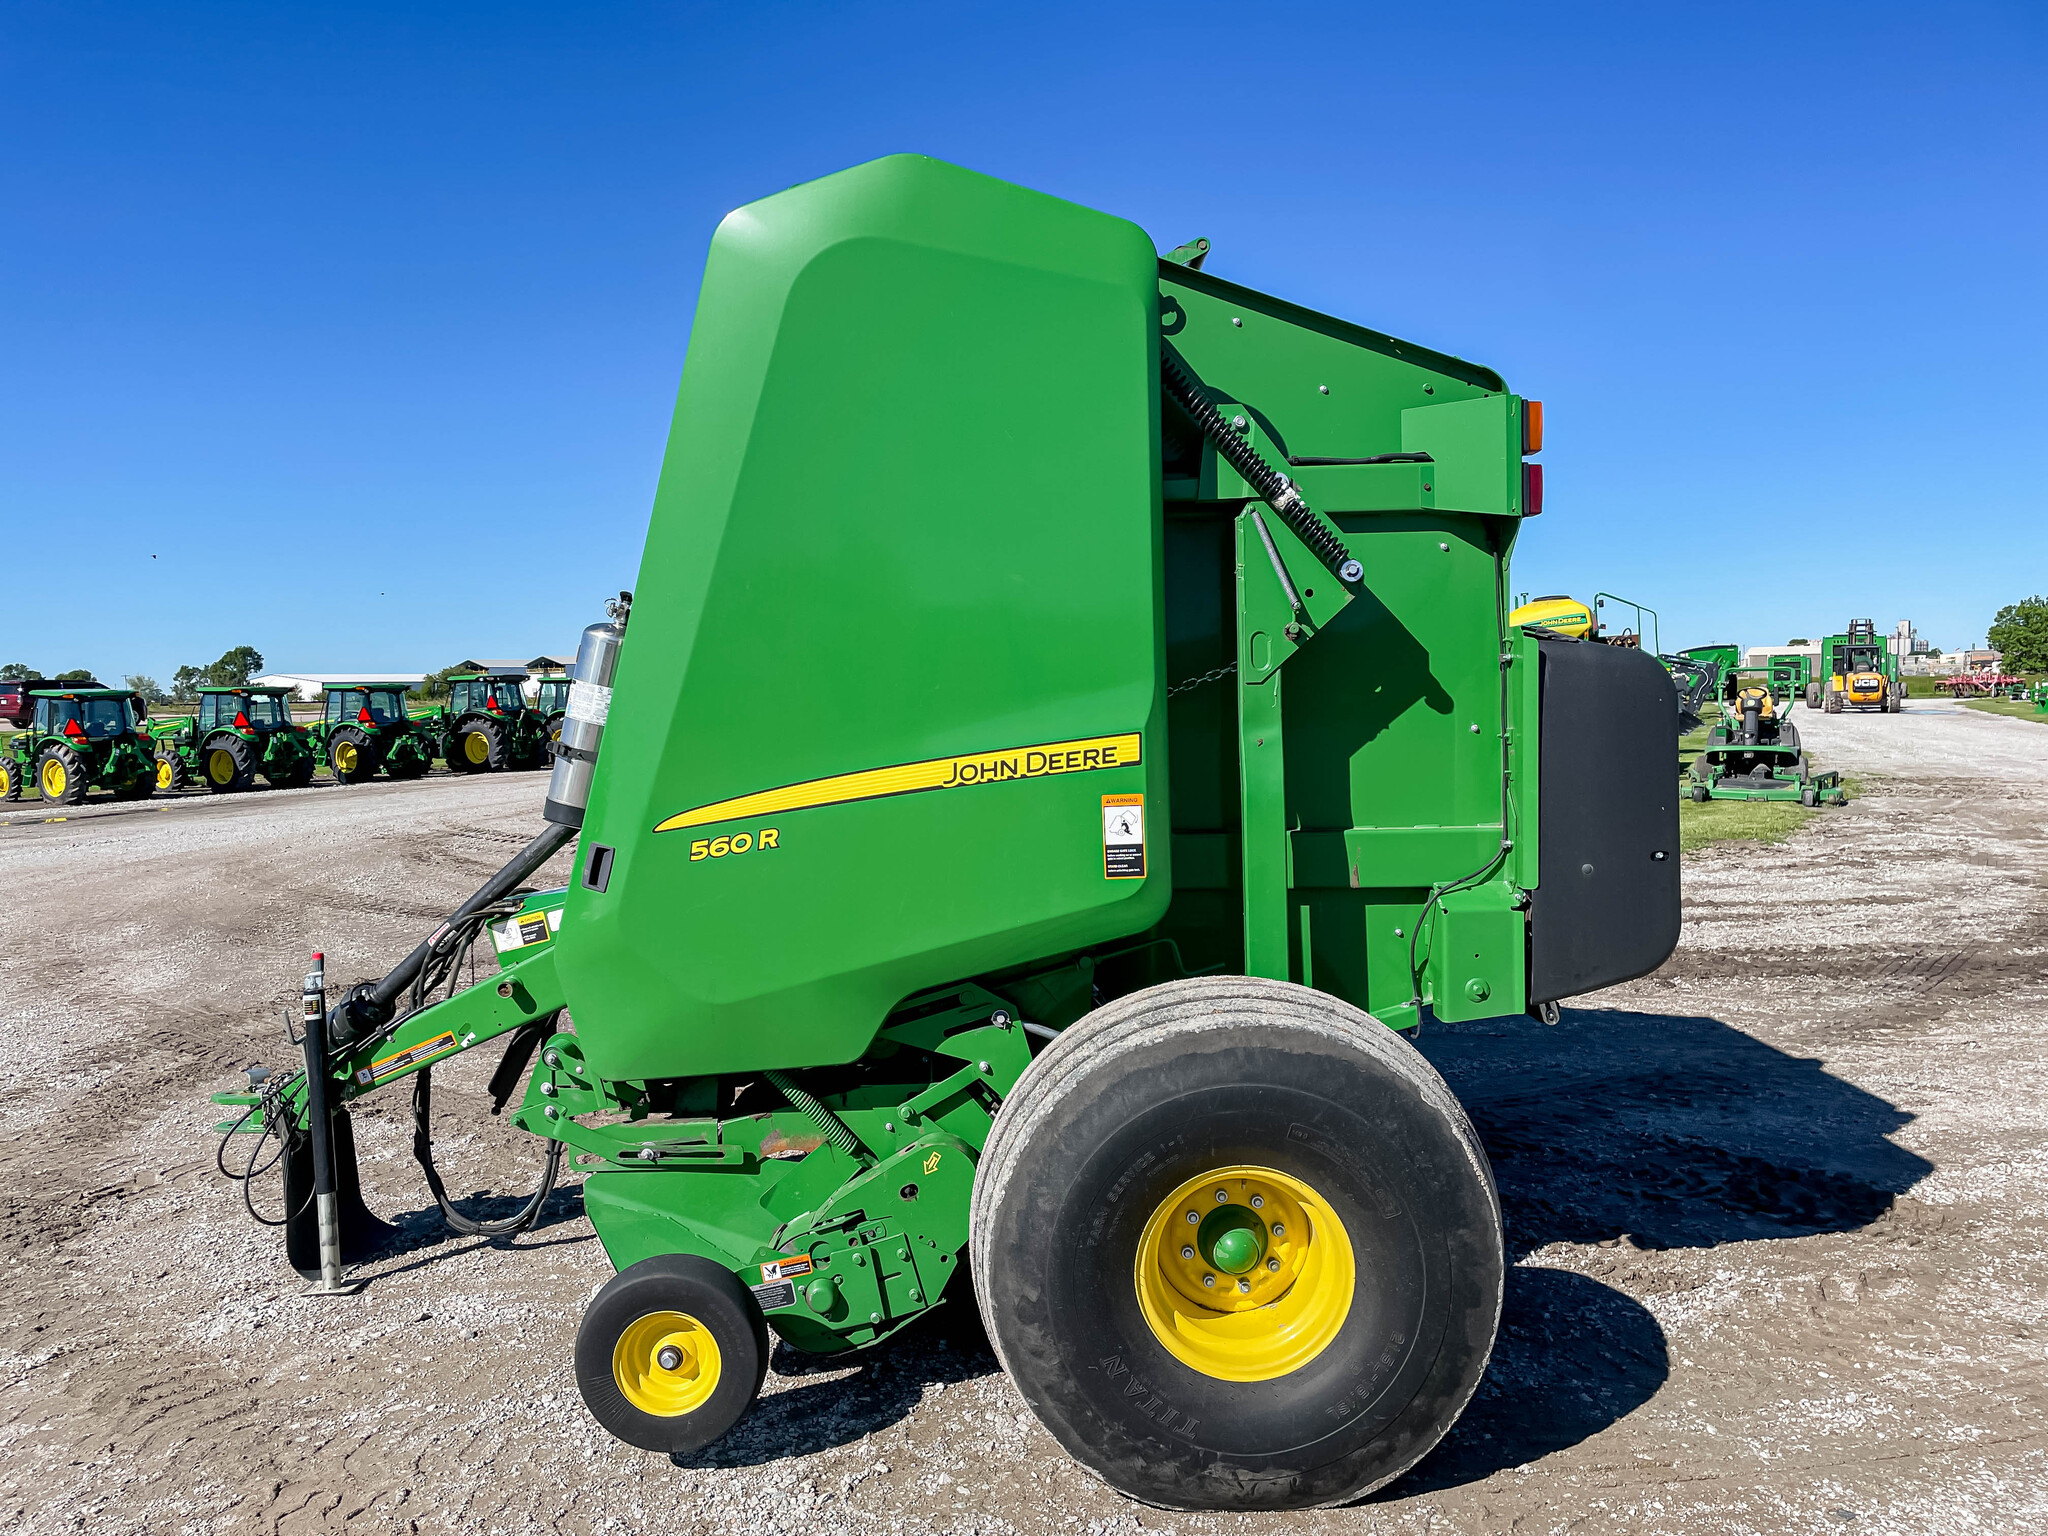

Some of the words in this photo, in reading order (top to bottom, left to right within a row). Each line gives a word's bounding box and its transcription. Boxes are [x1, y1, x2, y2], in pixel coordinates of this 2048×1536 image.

[943, 758, 1018, 785] JOHN
[1026, 746, 1118, 773] DEERE
[689, 832, 753, 862] 560
[757, 828, 780, 851] R
[1106, 1150, 1156, 1203] SERVICE
[1099, 1354, 1202, 1441] TITAN
